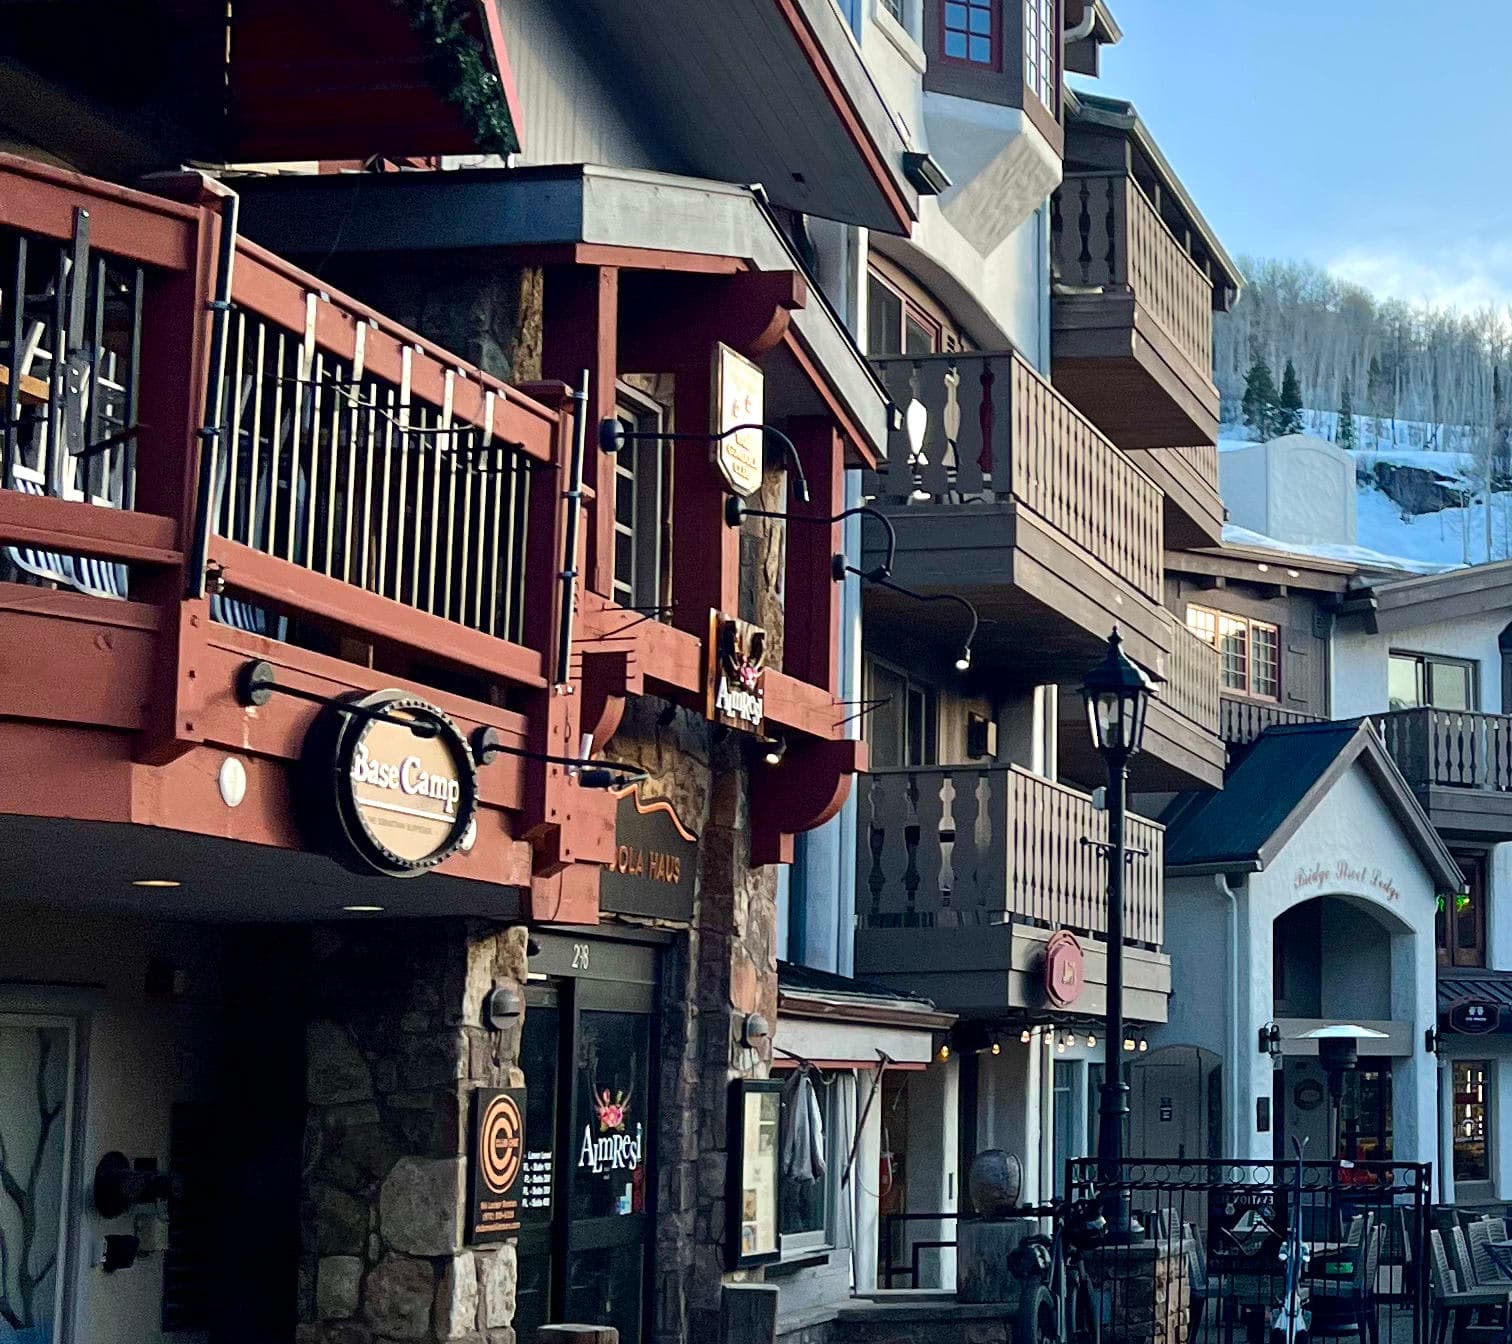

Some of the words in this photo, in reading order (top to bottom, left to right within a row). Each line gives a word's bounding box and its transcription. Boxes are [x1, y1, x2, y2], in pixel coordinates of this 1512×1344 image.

[648, 850, 680, 884] HAUS
[1294, 862, 1330, 890] Bridge
[1336, 859, 1367, 882] Street
